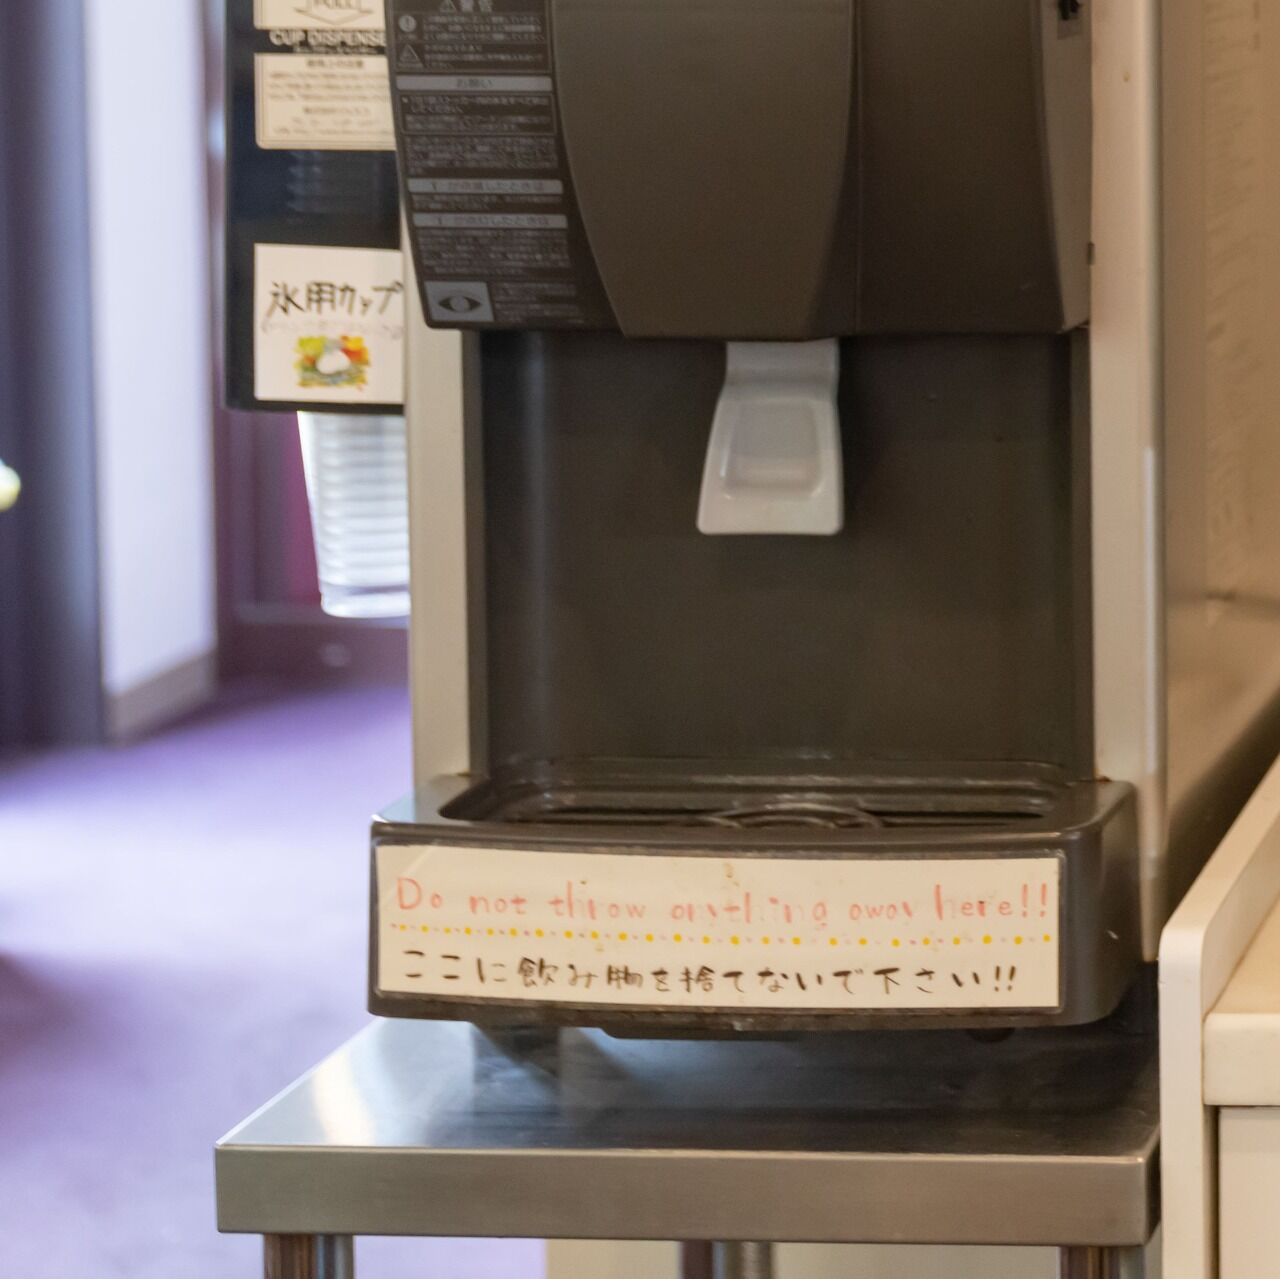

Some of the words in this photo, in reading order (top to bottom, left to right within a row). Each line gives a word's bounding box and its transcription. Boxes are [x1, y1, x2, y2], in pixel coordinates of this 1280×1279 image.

[265, 280, 403, 318] 氷用カップ
[397, 877, 443, 910] Do
[469, 892, 528, 915] not
